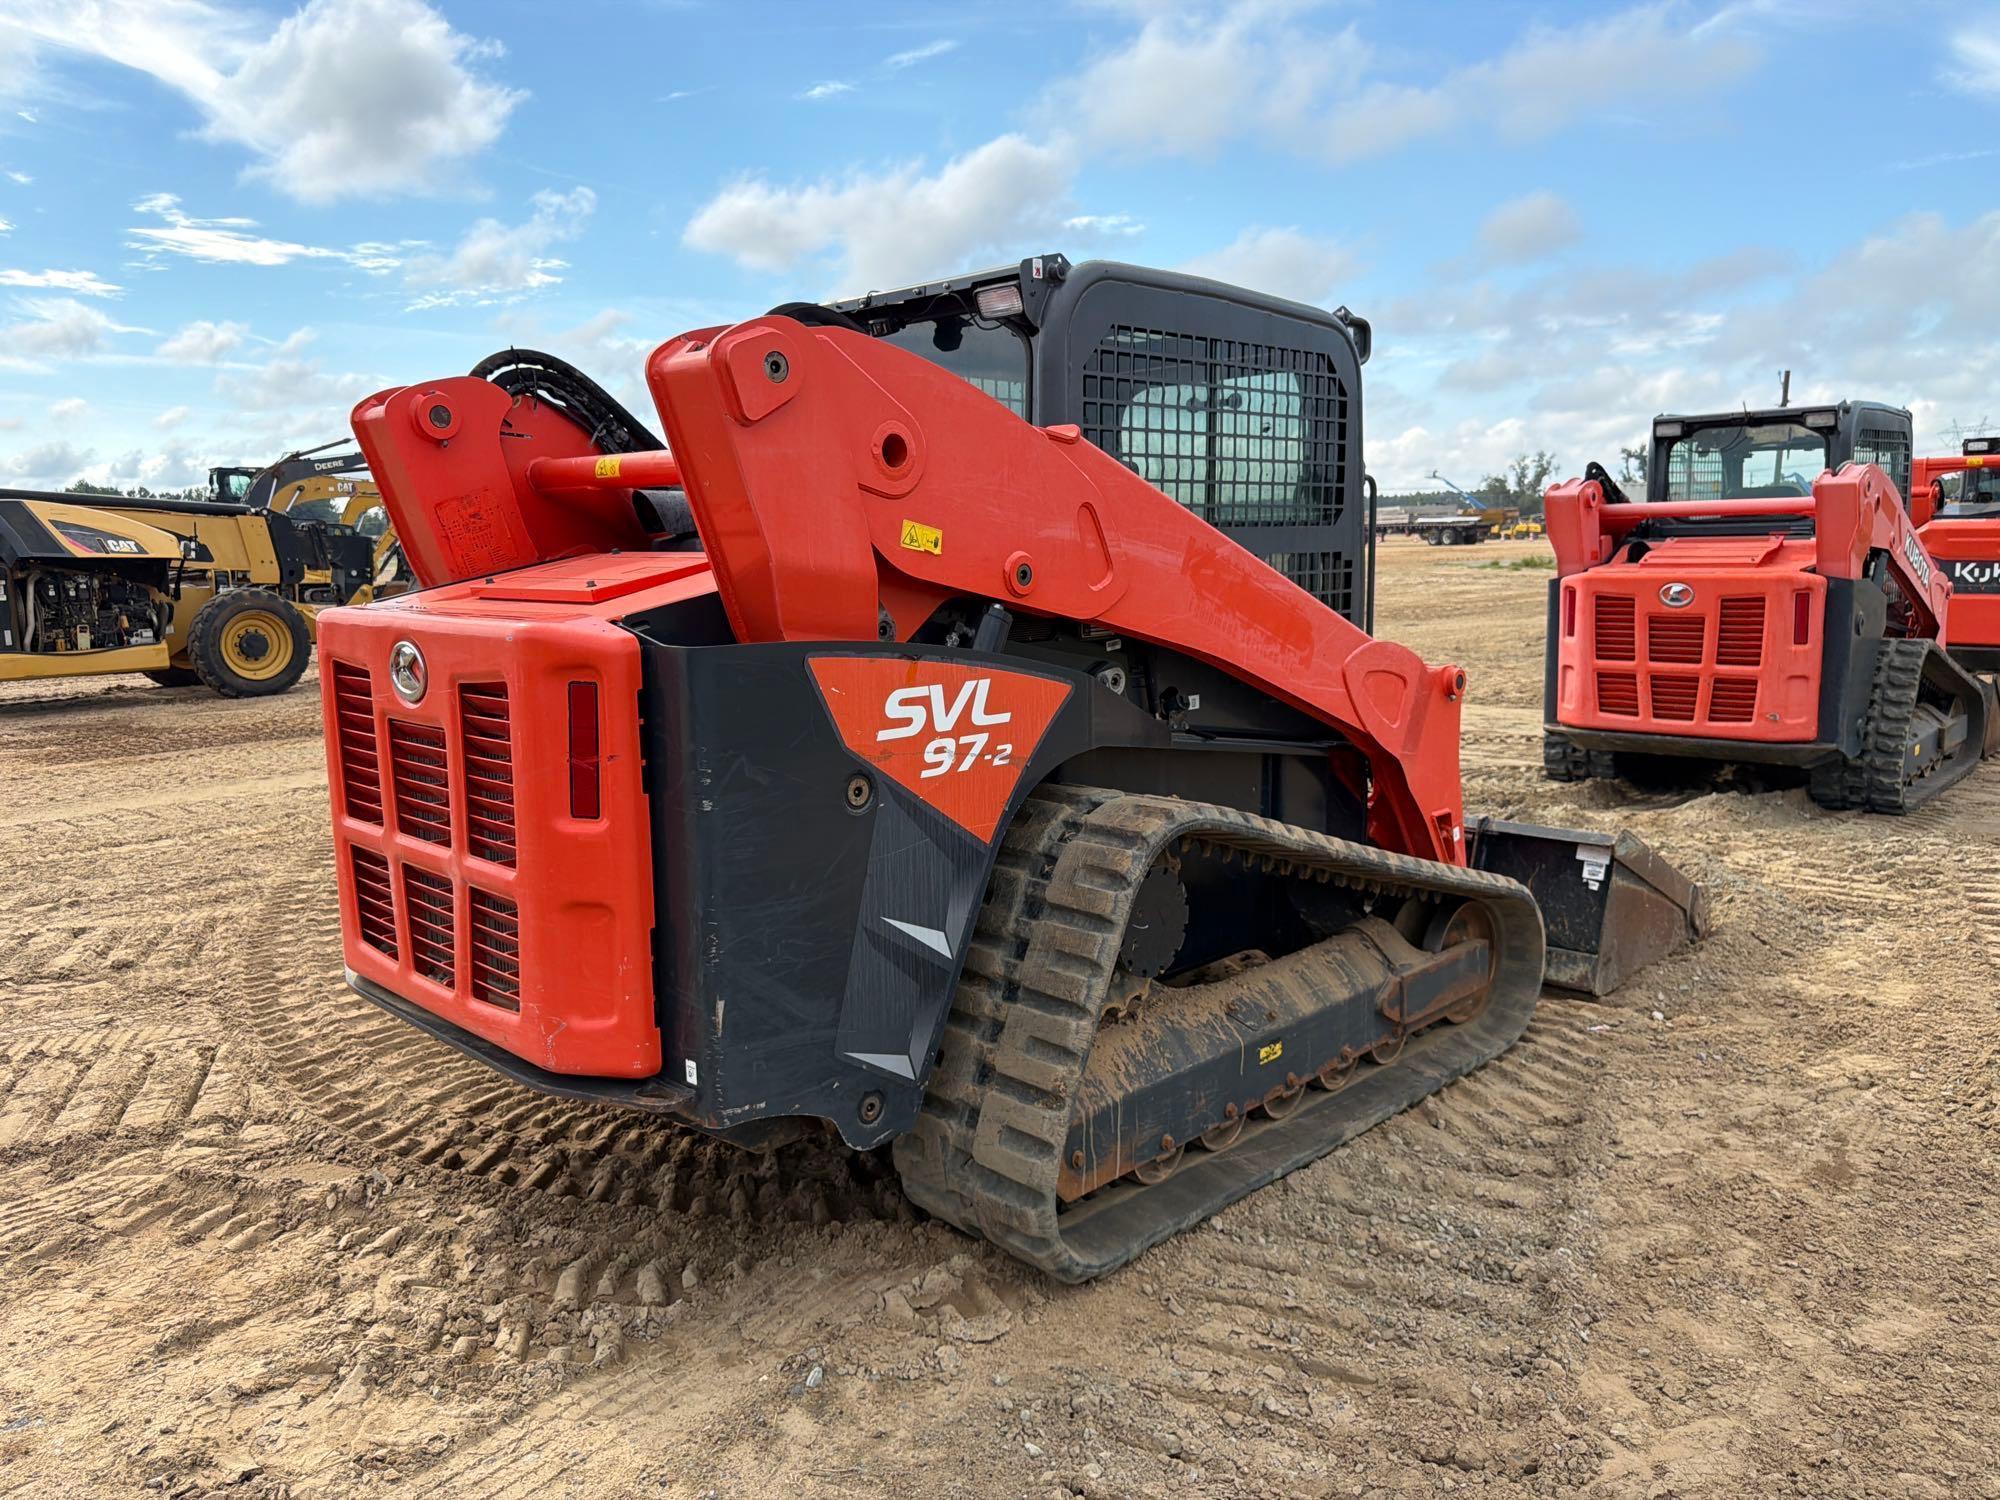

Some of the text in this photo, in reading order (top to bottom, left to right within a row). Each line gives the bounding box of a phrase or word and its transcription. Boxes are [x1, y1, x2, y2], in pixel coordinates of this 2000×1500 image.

[314, 459, 345, 471] DEERE
[337, 482, 354, 493] CAT
[107, 539, 139, 553] CAT
[1904, 532, 1930, 590] KUBOTA
[876, 678, 1012, 742] SVL
[920, 732, 1013, 779] 97-2
